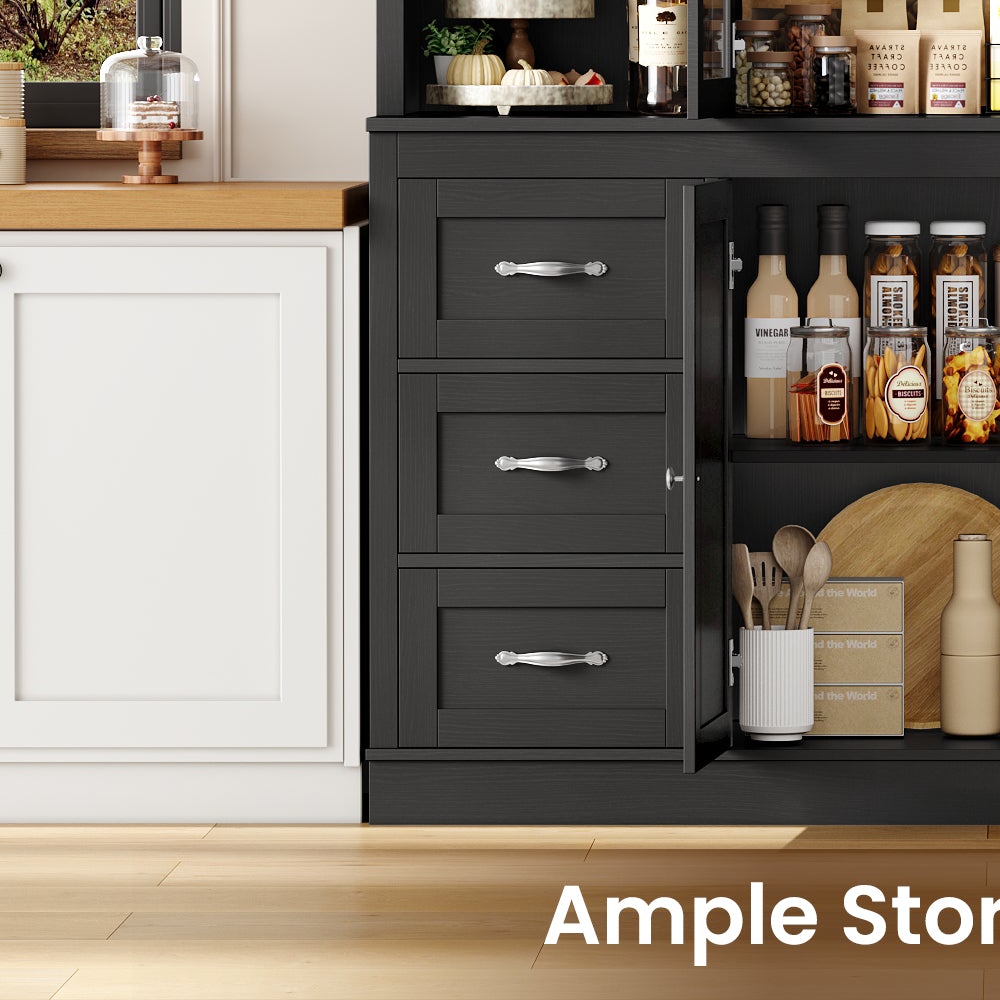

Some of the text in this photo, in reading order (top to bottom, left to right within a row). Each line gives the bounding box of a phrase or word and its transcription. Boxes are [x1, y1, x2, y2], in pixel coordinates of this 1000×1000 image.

[881, 286, 892, 327] ALMOND
[947, 286, 958, 327] ALMOND
[755, 328, 789, 337] VINEGAR
[964, 385, 993, 393] Biscuits
[827, 587, 844, 598] the
[846, 587, 877, 598] World
[827, 639, 844, 649] the
[846, 639, 877, 649] World
[827, 690, 844, 701] the
[846, 690, 877, 701] World
